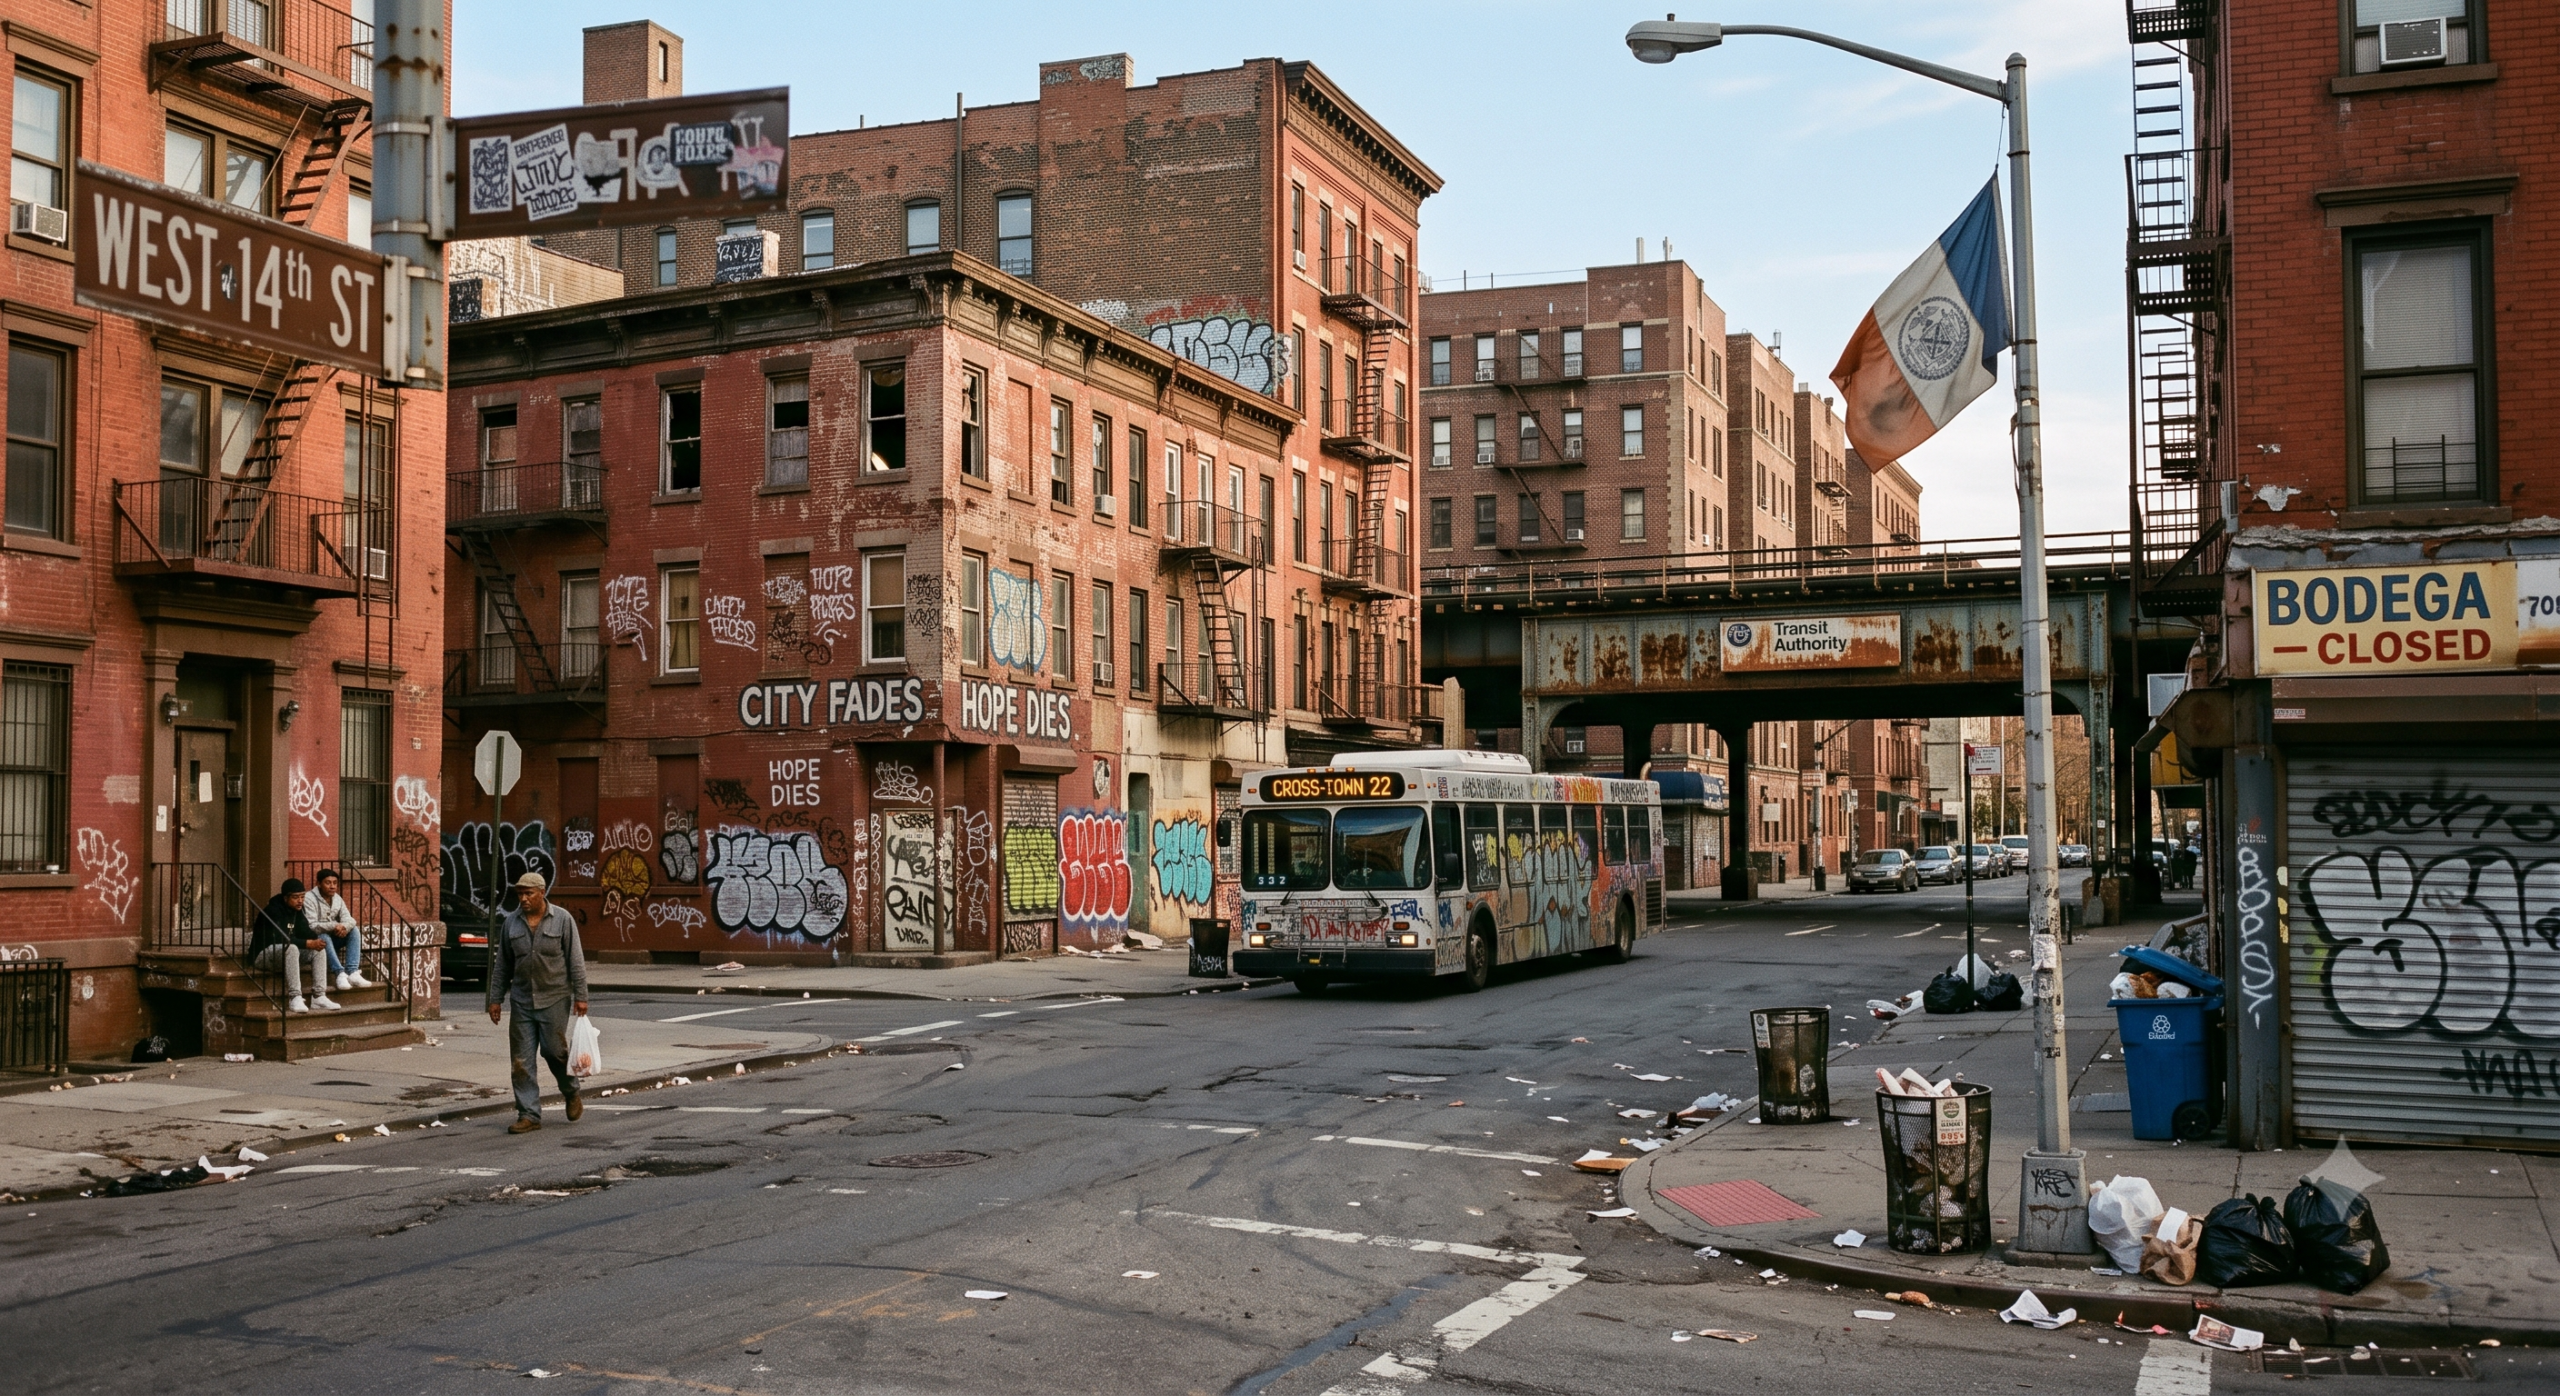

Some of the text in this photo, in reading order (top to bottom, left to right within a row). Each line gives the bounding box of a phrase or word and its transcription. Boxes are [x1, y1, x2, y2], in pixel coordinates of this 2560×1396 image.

[94, 193, 375, 353] WEST 14th ST
[2267, 571, 2491, 625] BODEGA
[1774, 621, 1828, 635] Transit
[1774, 636, 1847, 652] Authority
[2318, 629, 2491, 665] CLOSED
[738, 677, 925, 728] CITY FADES
[961, 680, 1071, 740] HOPE DIES
[769, 758, 821, 781] HOPE
[771, 783, 821, 807] DIES
[1273, 776, 1391, 797] CROSS-TOWN 22
